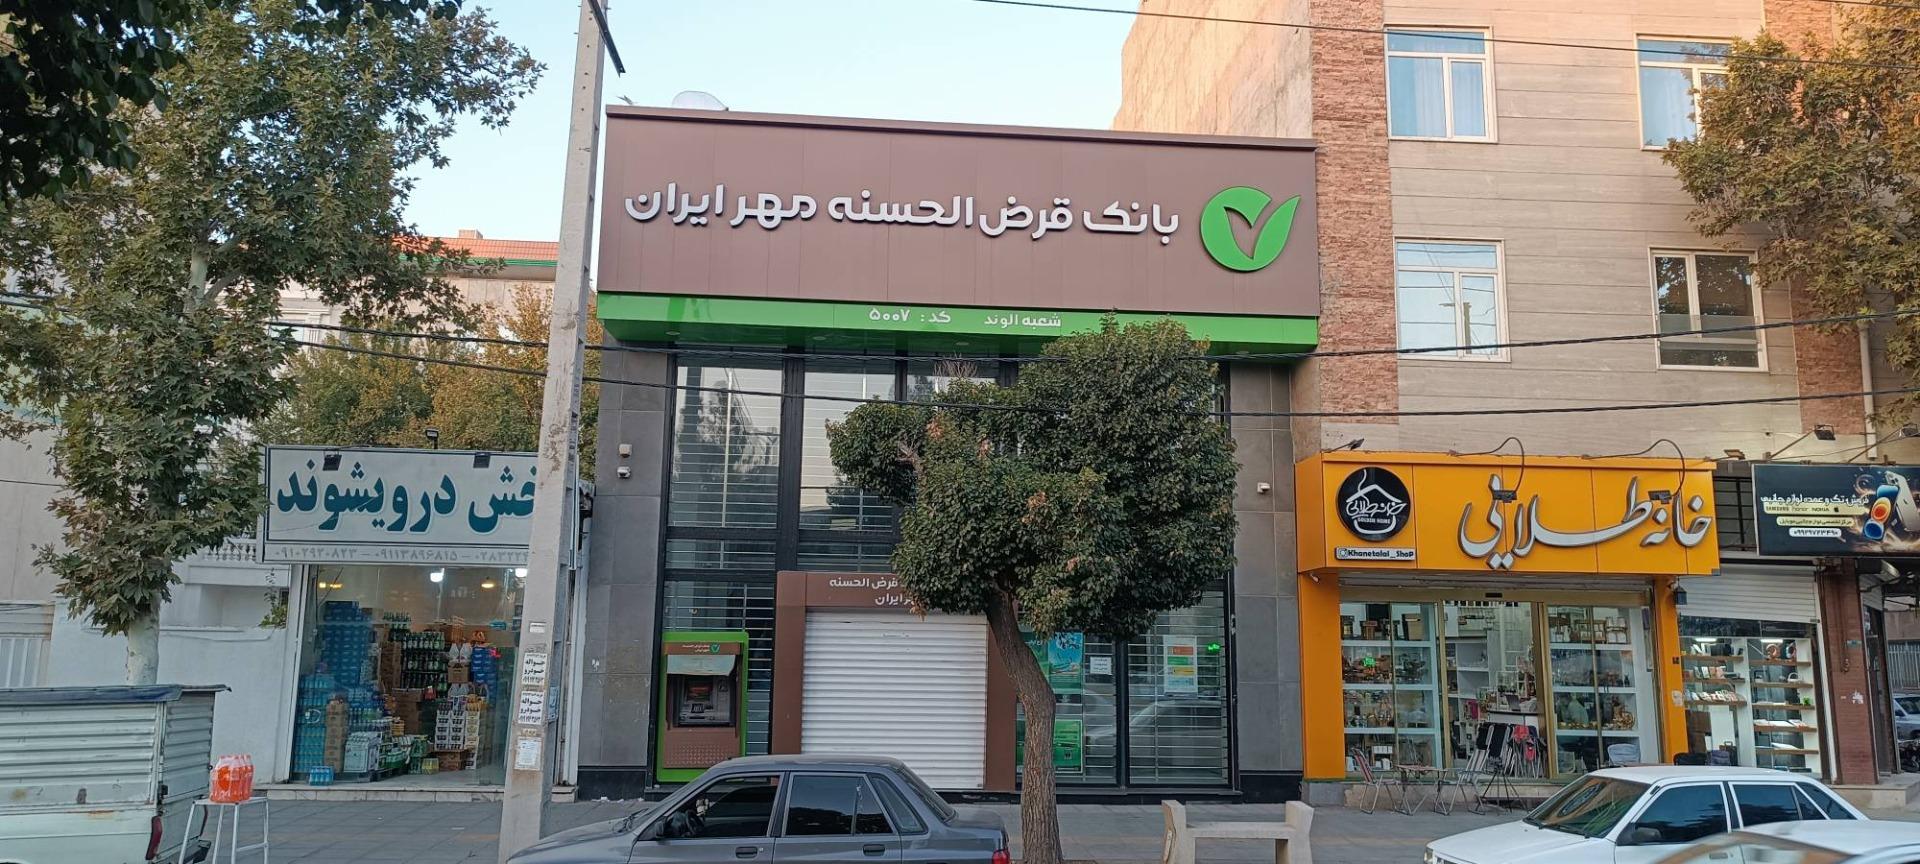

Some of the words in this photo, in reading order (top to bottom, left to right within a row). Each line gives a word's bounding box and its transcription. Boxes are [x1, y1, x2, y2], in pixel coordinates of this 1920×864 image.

[624, 182, 724, 225] ایران
[729, 191, 818, 231] مهر
[827, 189, 974, 228] الحسنه
[979, 195, 1073, 241] قرض
[1083, 200, 1179, 246] بانک
[869, 308, 910, 322] ۵۰۰۷
[984, 313, 1018, 329] الوند
[1022, 312, 1061, 329] شعبه
[277, 459, 456, 532] درویشوند
[468, 465, 537, 533] خش
[1760, 493, 1785, 505] جانبی
[1785, 493, 1803, 506] لوازم
[1830, 493, 1845, 503] تک
[1846, 493, 1870, 507] فروش
[1457, 473, 1654, 570] طلایی
[1639, 489, 1712, 548] خانه
[829, 576, 870, 588] الحسنه
[874, 593, 903, 606] ایران
[522, 697, 543, 706] حواله
